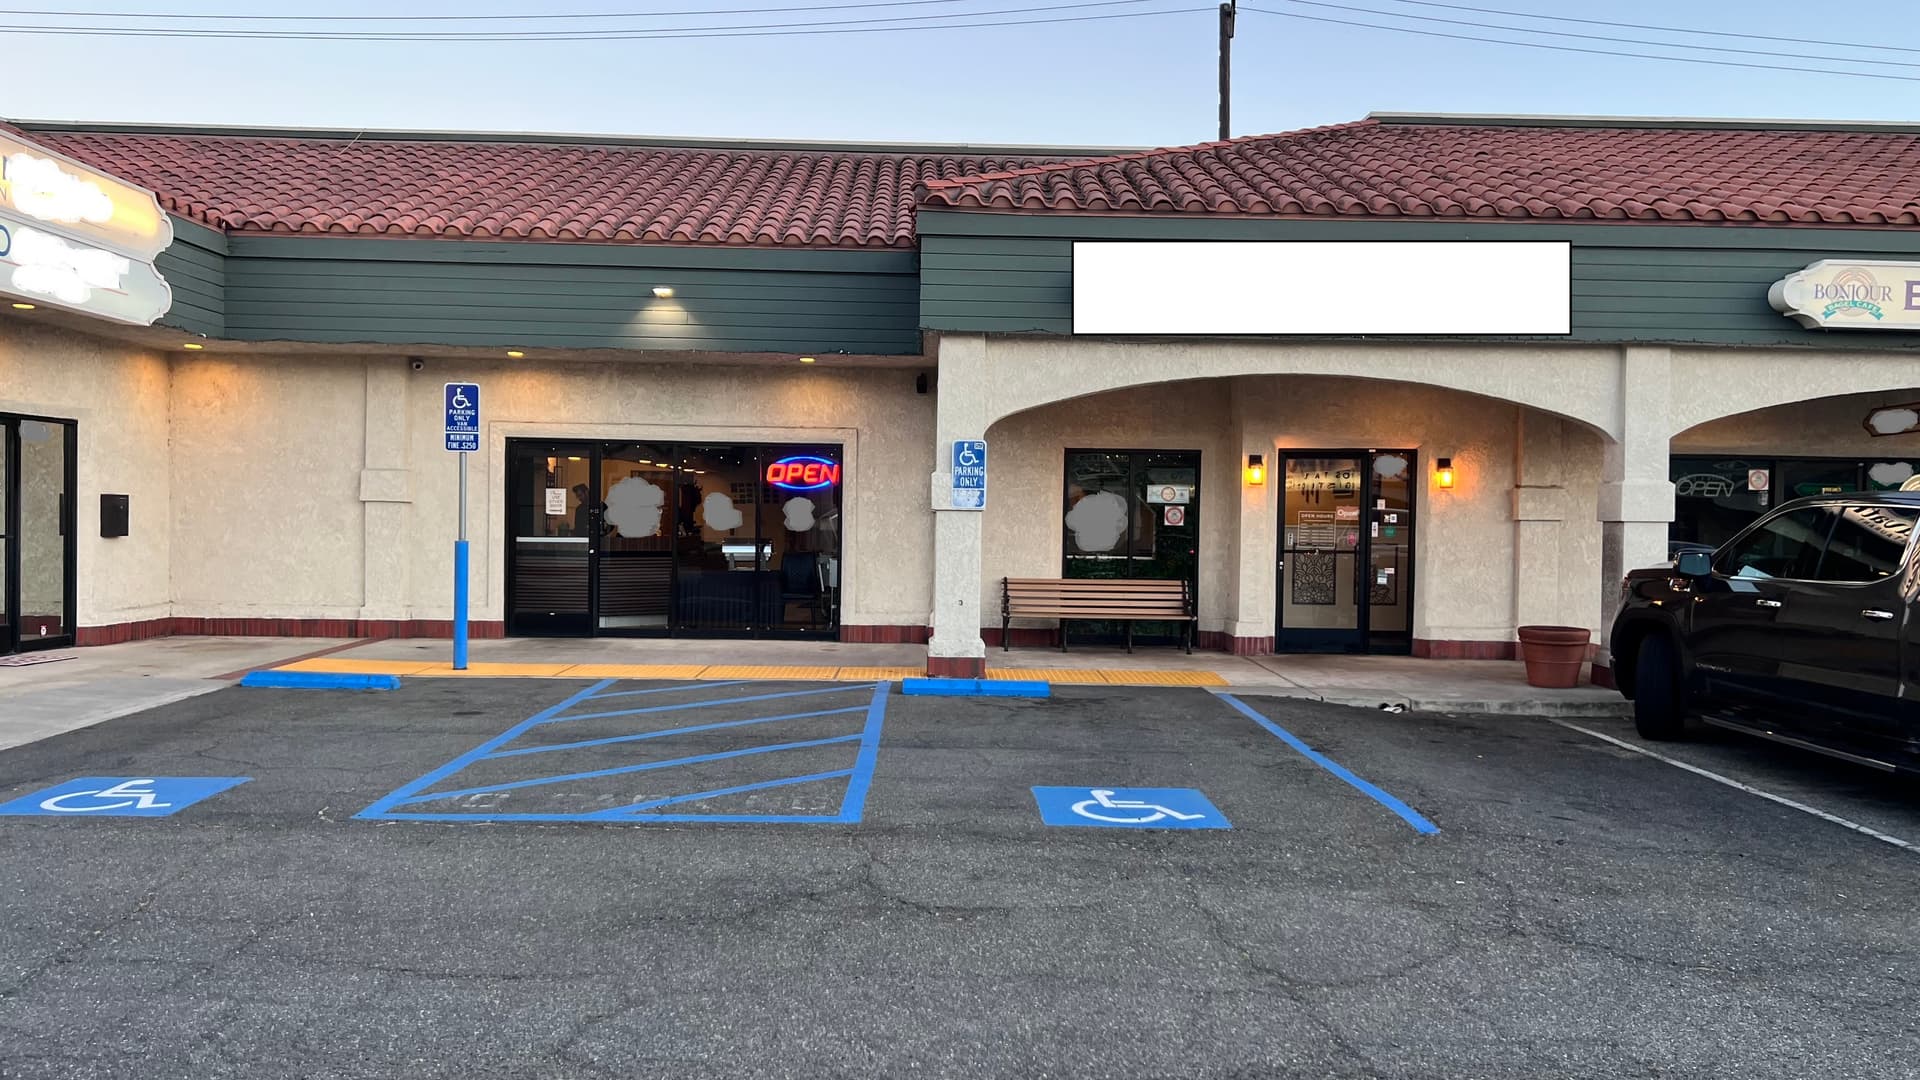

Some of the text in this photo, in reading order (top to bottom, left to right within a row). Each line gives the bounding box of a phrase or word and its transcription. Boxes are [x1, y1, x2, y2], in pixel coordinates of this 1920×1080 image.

[1814, 283, 1893, 302] BONJOUR
[1827, 300, 1855, 312] BAGEL
[449, 434, 475, 442] MINIMUM
[447, 441, 460, 449] FINE
[766, 463, 840, 486] OPEN
[954, 466, 985, 477] PARKING
[959, 476, 979, 487] ONLY
[1676, 479, 1735, 498] OPEN
